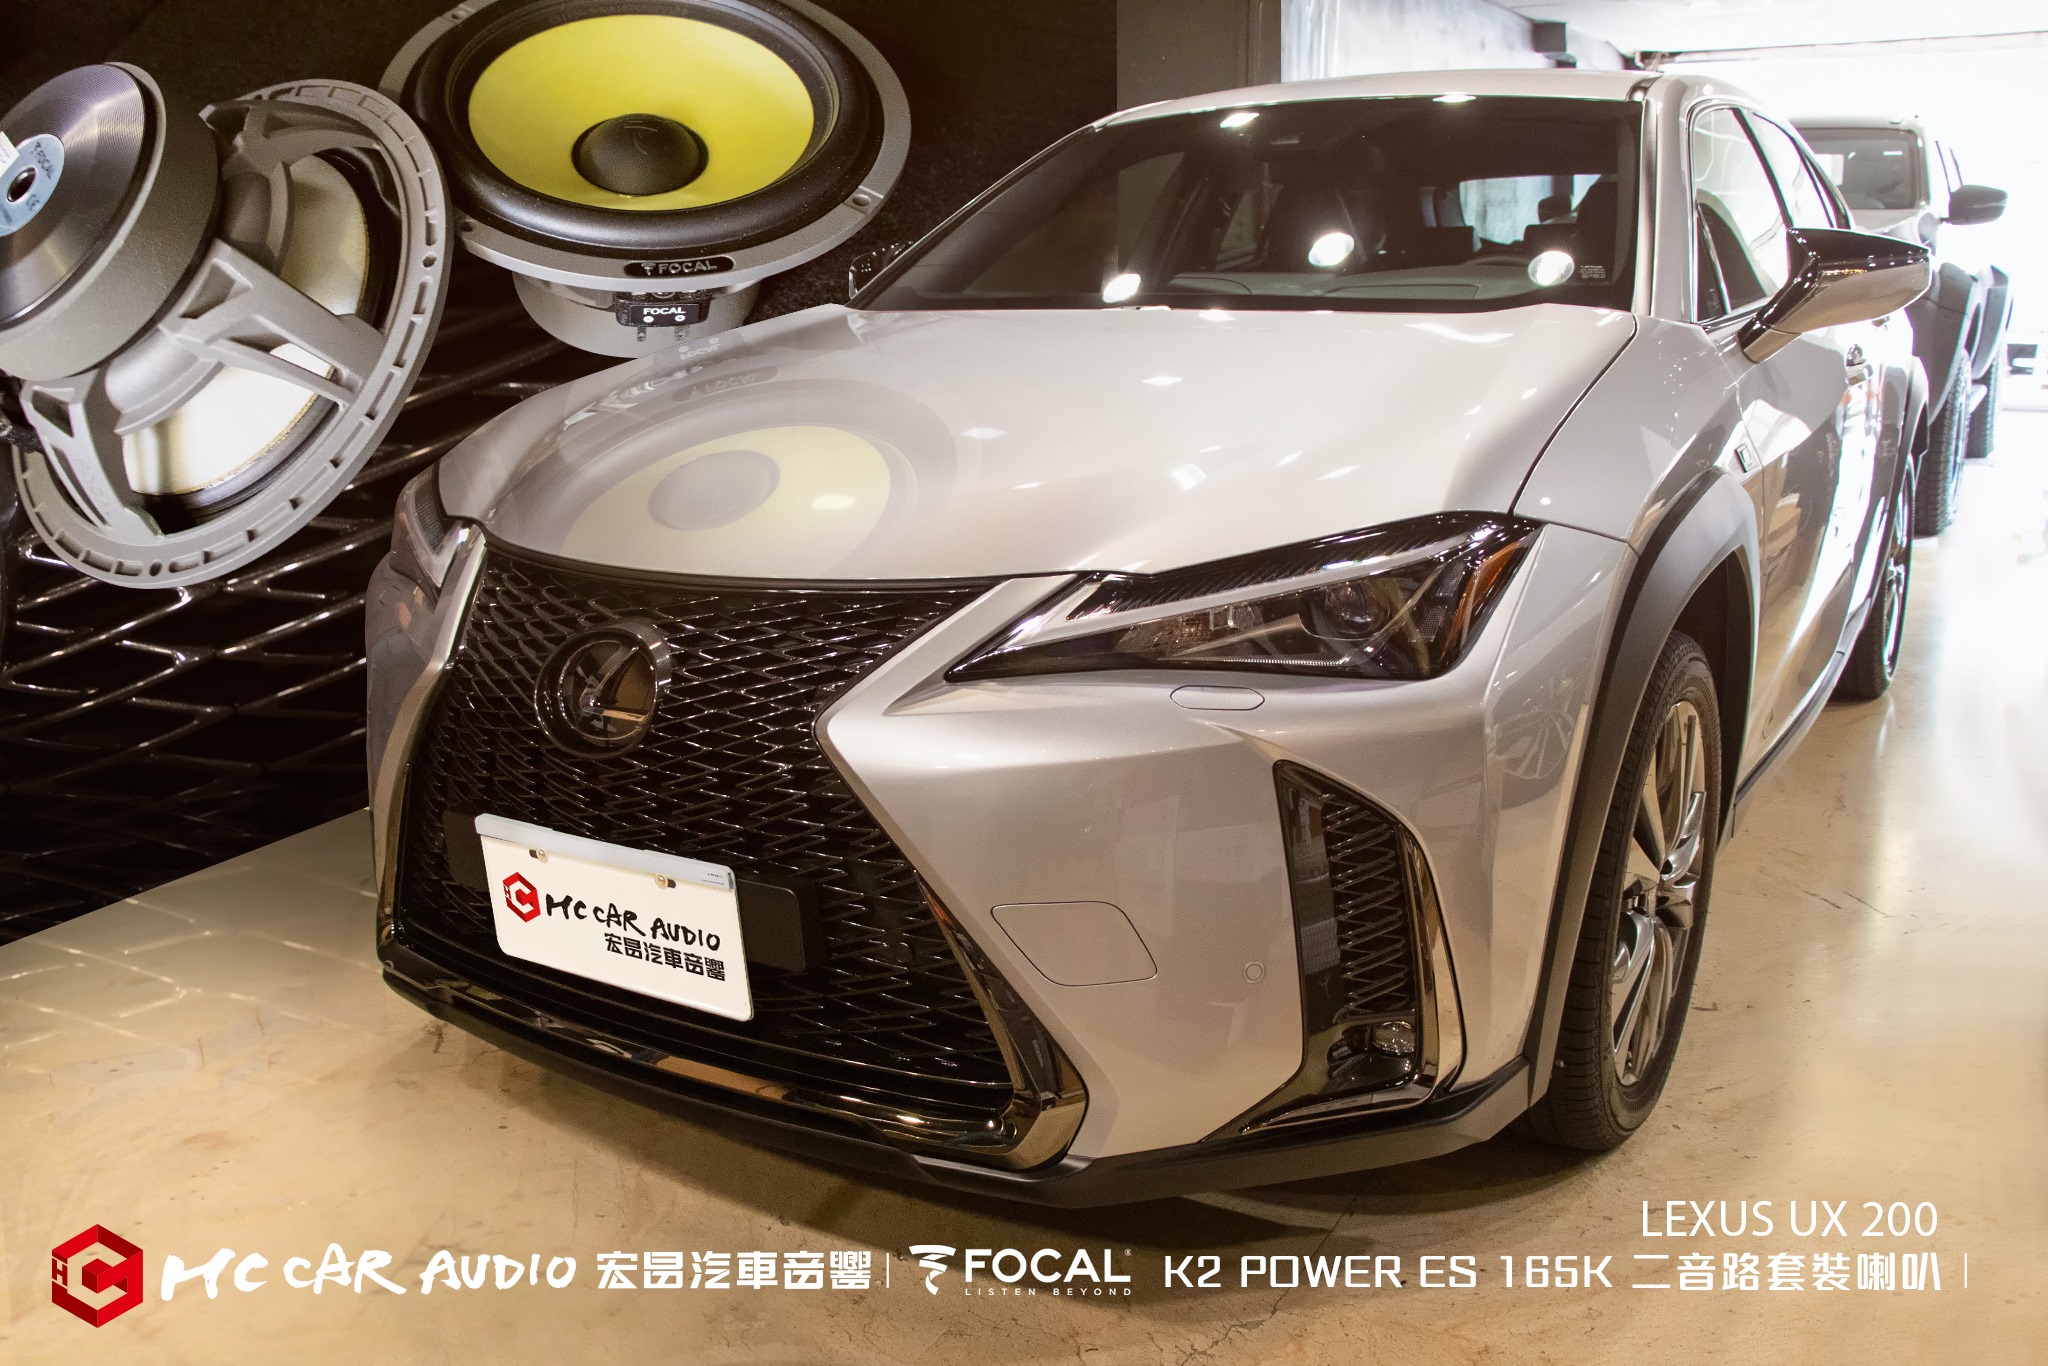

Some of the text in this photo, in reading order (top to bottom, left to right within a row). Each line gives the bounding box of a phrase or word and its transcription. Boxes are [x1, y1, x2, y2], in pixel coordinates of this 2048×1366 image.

[658, 260, 718, 274] FOCAL
[643, 306, 686, 315] FOCAL
[592, 902, 647, 937] CAR
[650, 917, 721, 951] AUDIO
